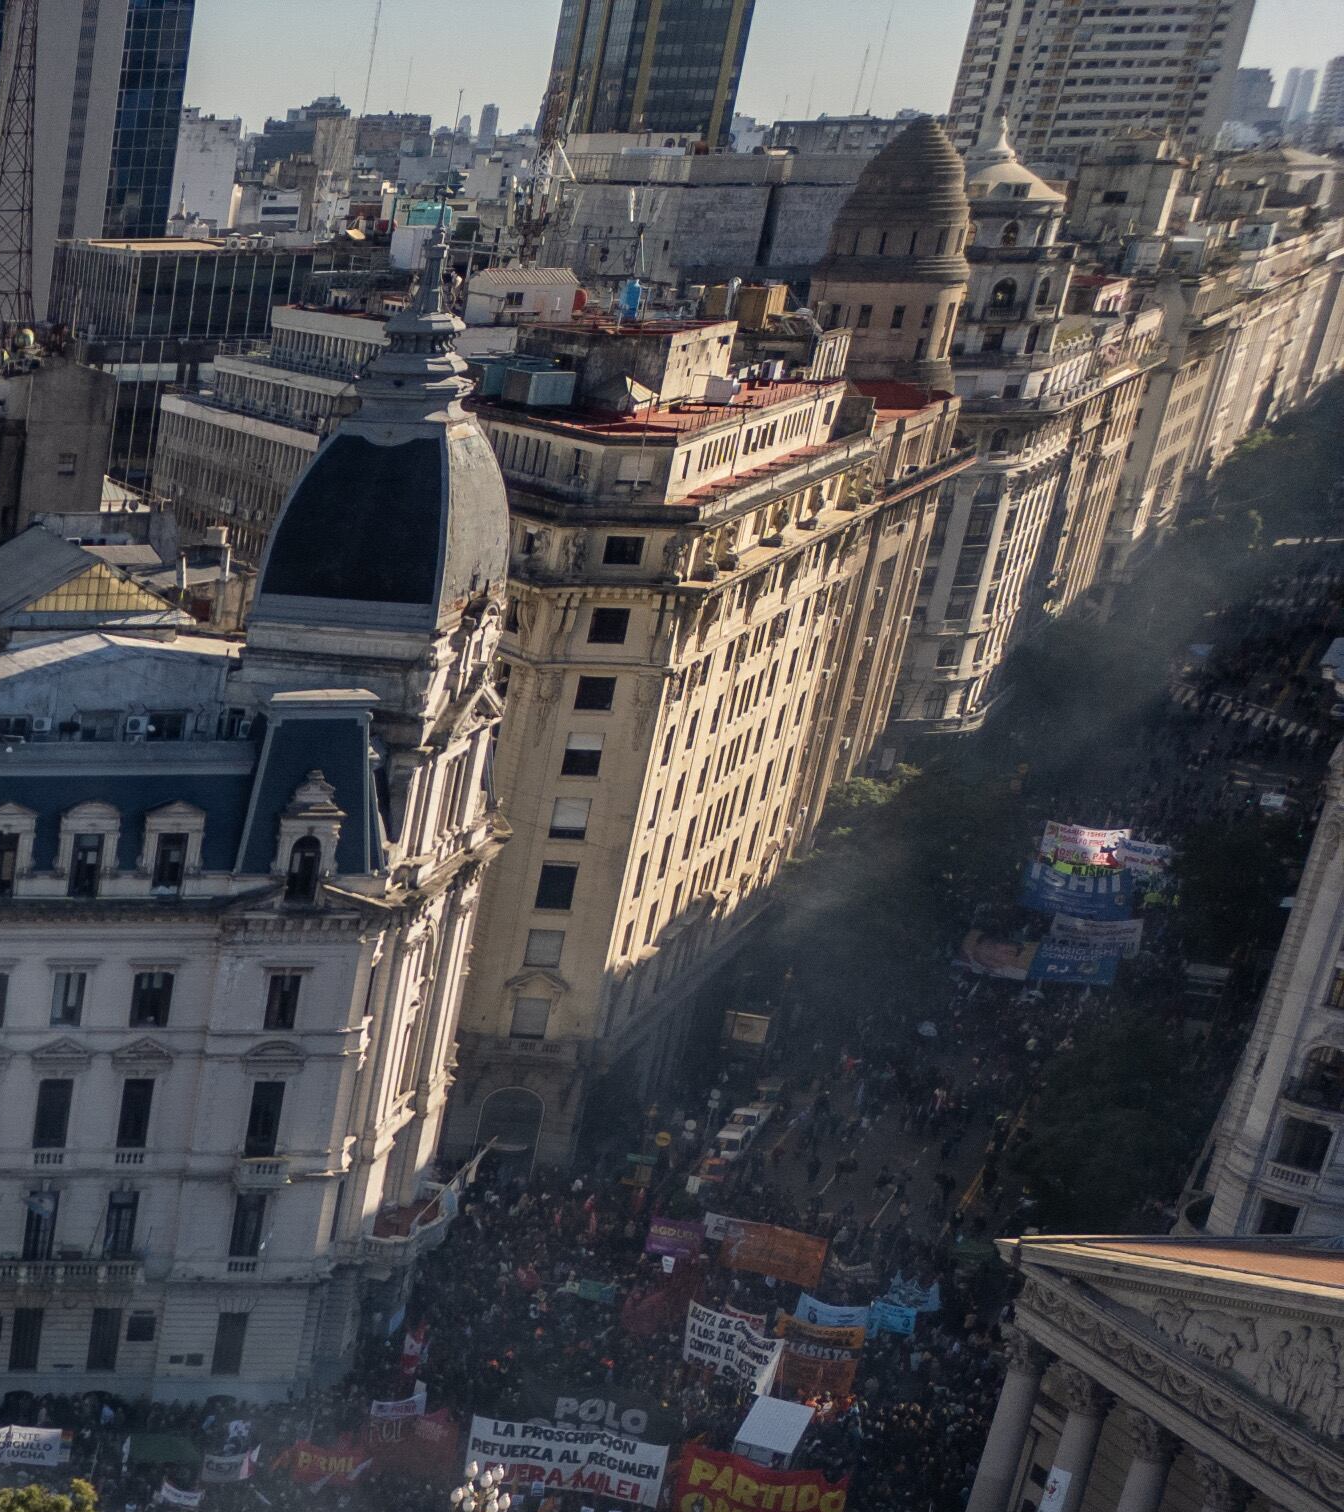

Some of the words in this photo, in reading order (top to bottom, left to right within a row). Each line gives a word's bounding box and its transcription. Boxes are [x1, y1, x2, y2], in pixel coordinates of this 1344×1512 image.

[554, 1396, 648, 1435] POLO
[492, 1420, 517, 1438] LA
[6, 1450, 46, 1461] LUCHA
[470, 1437, 554, 1463] REFUERZA
[558, 1447, 583, 1465] AL
